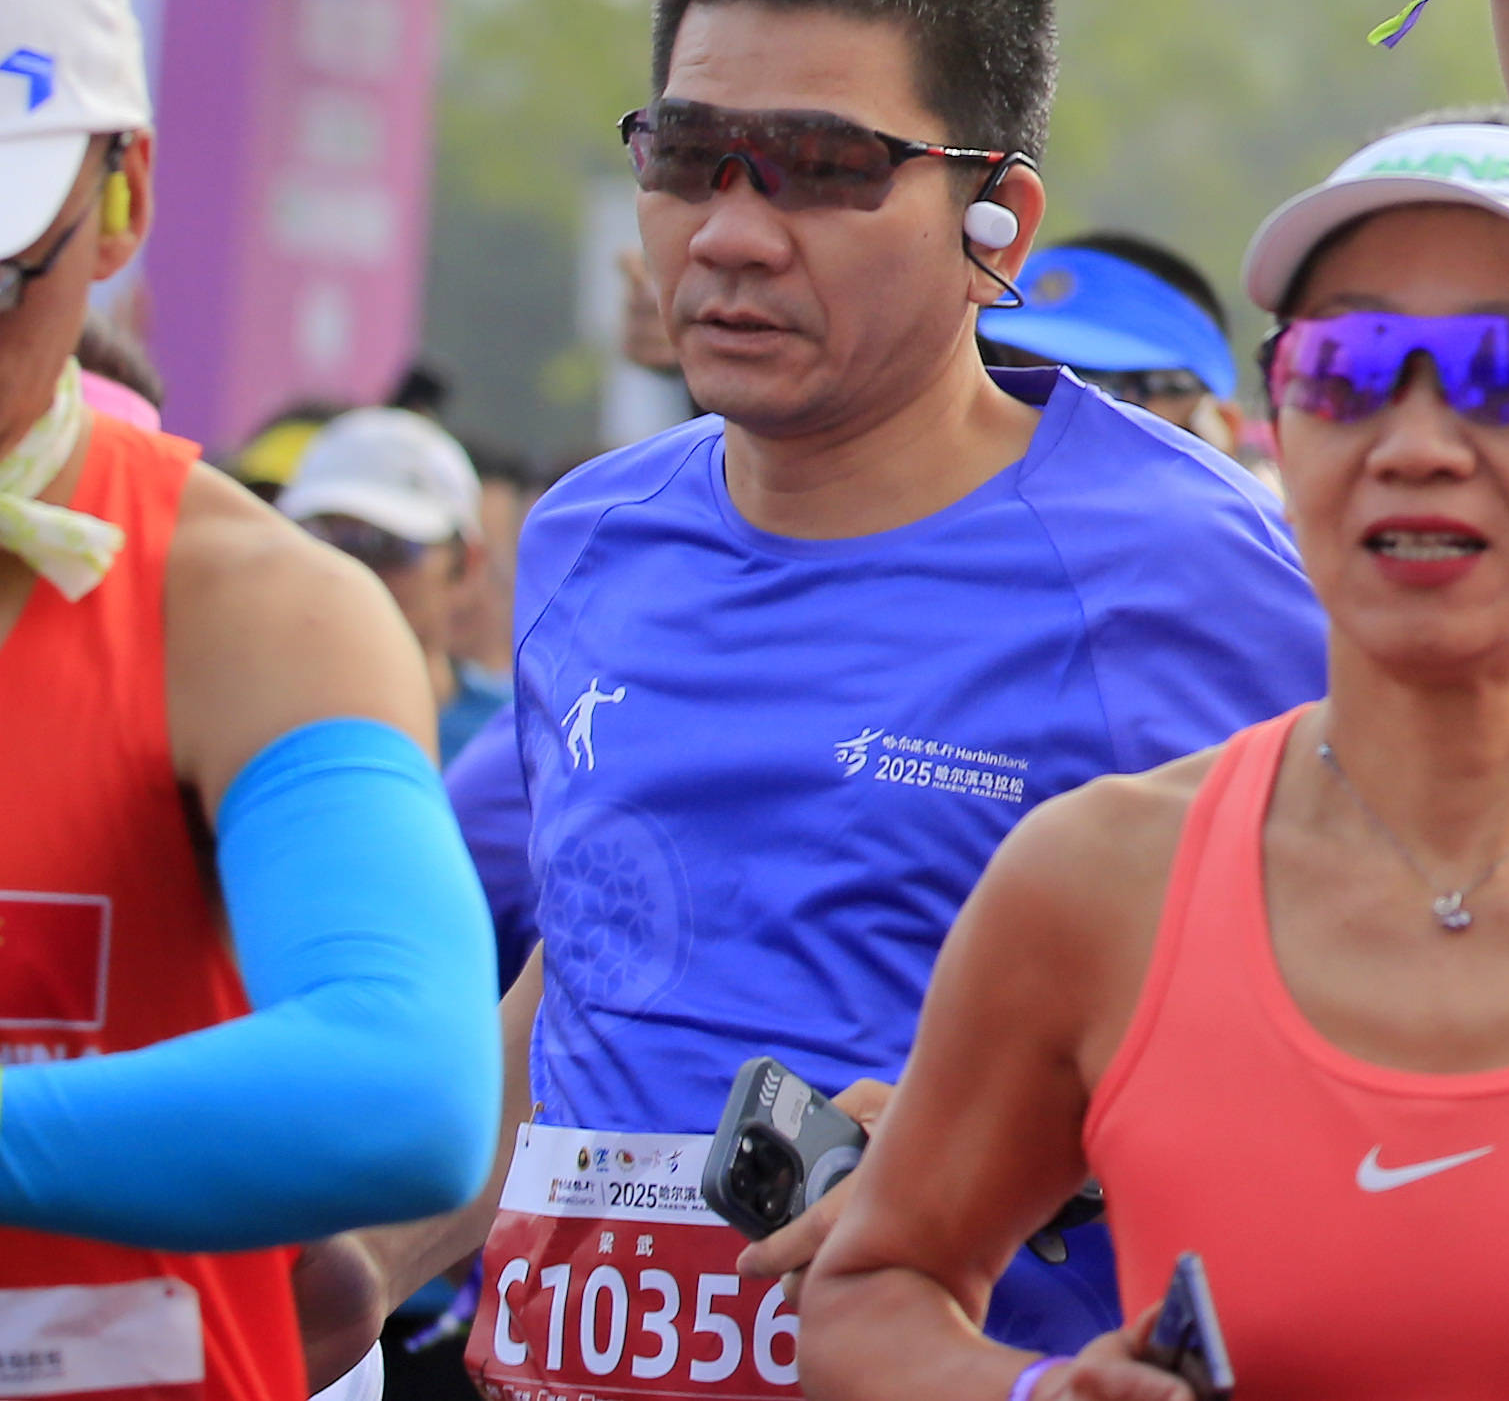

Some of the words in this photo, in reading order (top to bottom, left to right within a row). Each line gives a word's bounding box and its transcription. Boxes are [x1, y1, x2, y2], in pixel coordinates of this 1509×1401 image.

[874, 754, 933, 787] 2025
[608, 1182, 657, 1209] 2025
[494, 1257, 799, 1386] C10356
